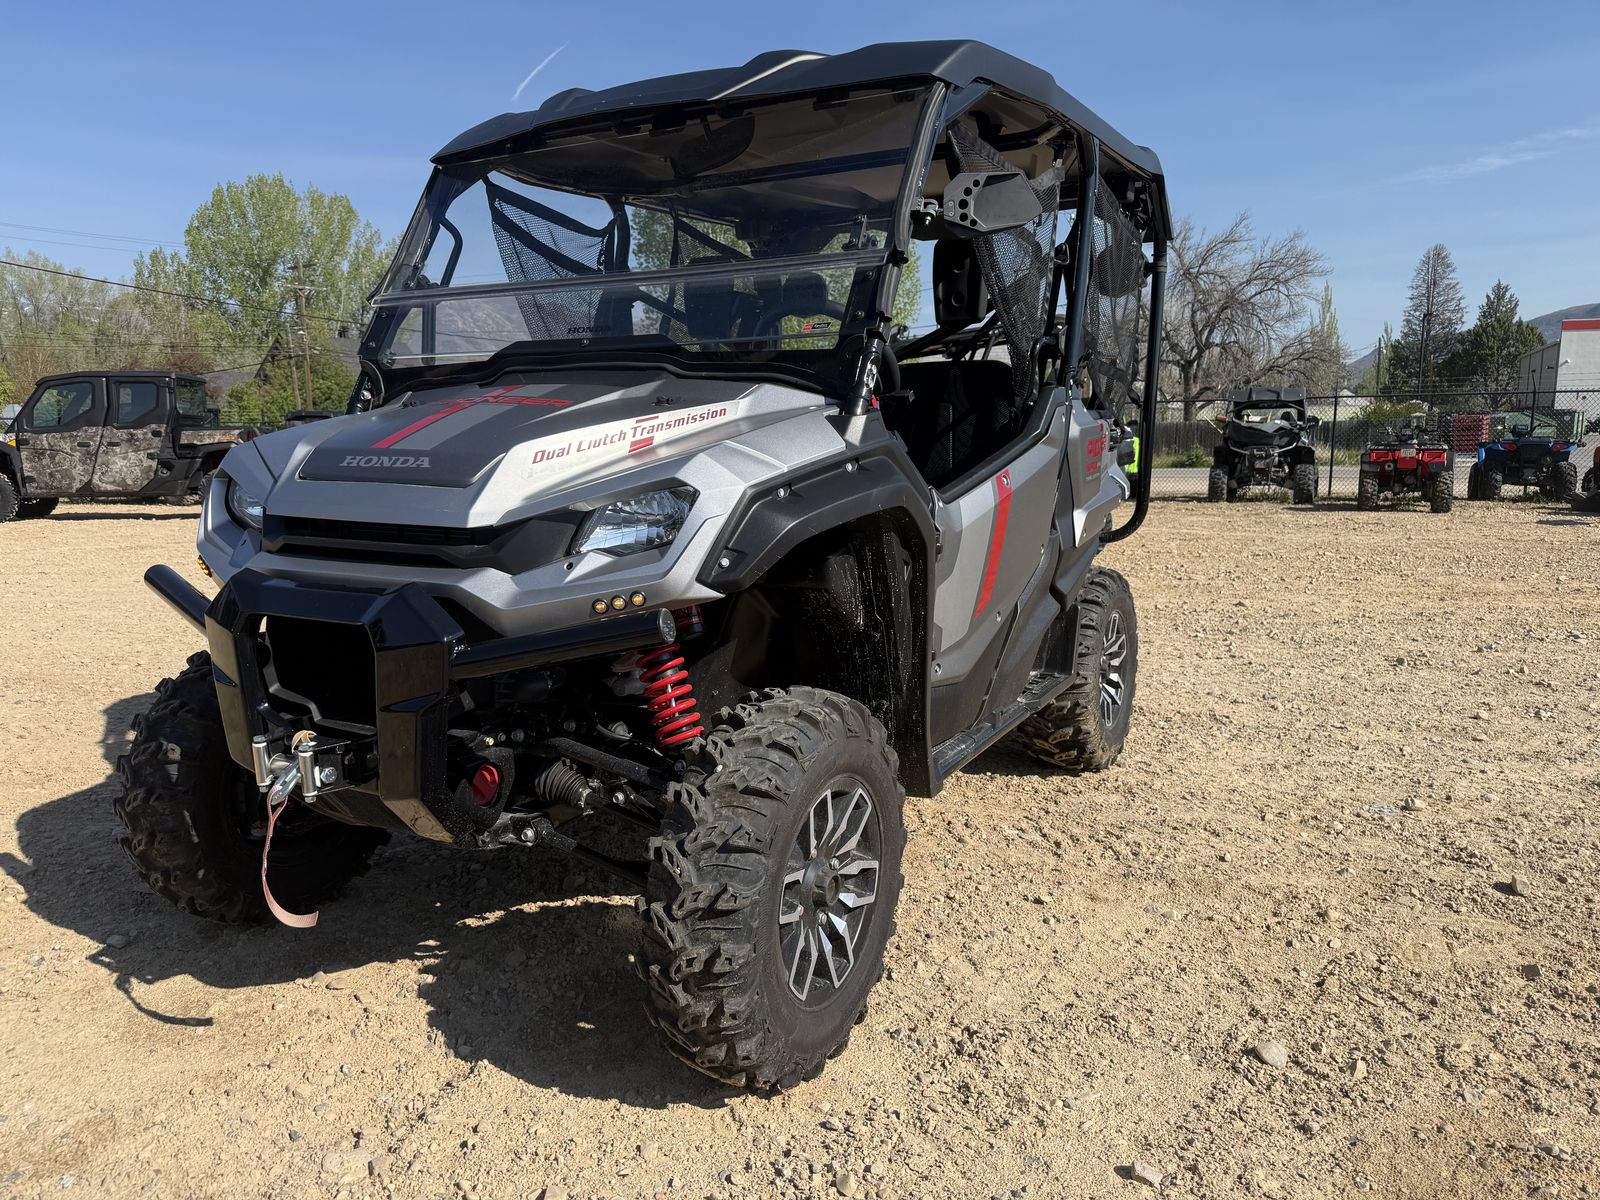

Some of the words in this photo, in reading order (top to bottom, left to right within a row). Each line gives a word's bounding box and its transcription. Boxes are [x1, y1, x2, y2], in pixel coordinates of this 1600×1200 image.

[532, 443, 572, 464] Dual
[631, 408, 726, 439] Transmission
[339, 455, 432, 467] HONDA
